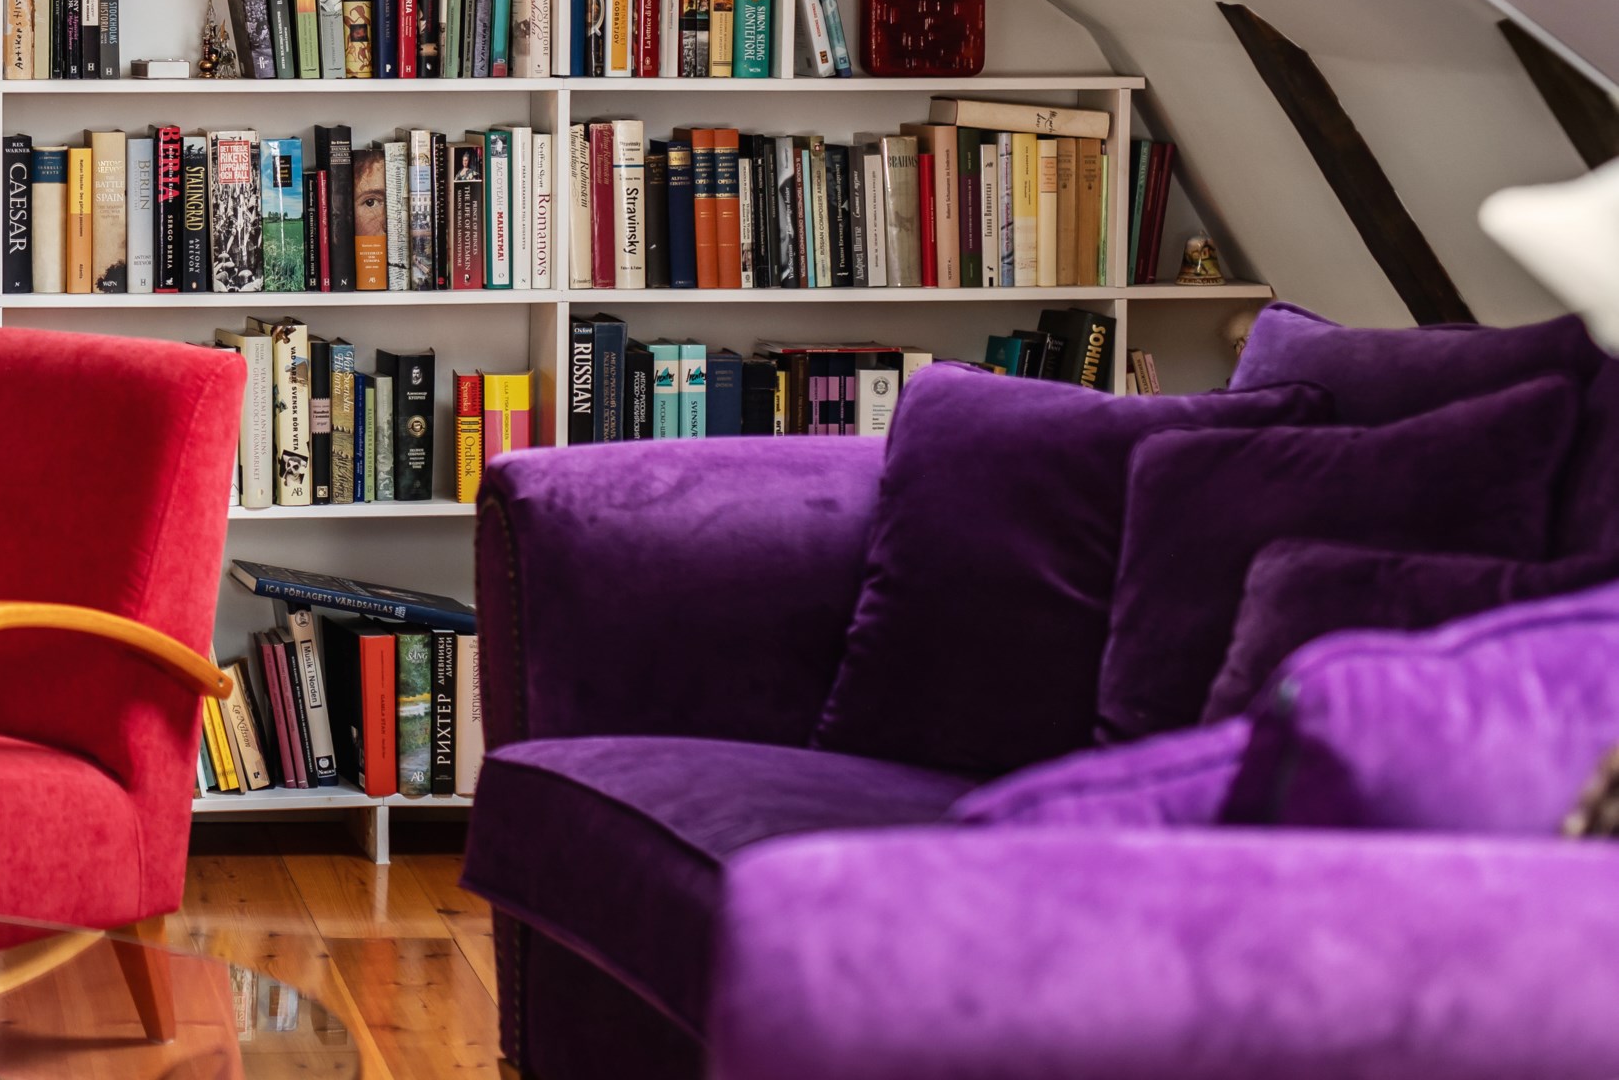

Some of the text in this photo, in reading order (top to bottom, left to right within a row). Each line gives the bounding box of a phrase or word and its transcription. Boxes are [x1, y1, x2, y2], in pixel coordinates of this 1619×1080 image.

[100, 2, 109, 32] HISTORIA
[108, 2, 117, 44] STOCKHOLMS
[744, 5, 756, 60] MONTEFIORE
[756, 5, 766, 60] SIMON SEBAG
[9, 162, 27, 254] CAESAR
[184, 166, 206, 231] STALINGRAD
[464, 218, 471, 228] OF
[473, 219, 478, 230] OF
[537, 193, 551, 276] Romanovs
[623, 187, 639, 256] Stravinsky
[573, 342, 592, 414] RUSSIAN
[463, 436, 475, 477] Ordbok
[265, 583, 393, 614] ICA FÖRLAGETS VÄRLDSATLAS
[303, 646, 313, 669] Musik
[307, 675, 318, 703] Norden
[236, 718, 253, 748] Nilsson
[435, 693, 452, 765] РИХТЕР
